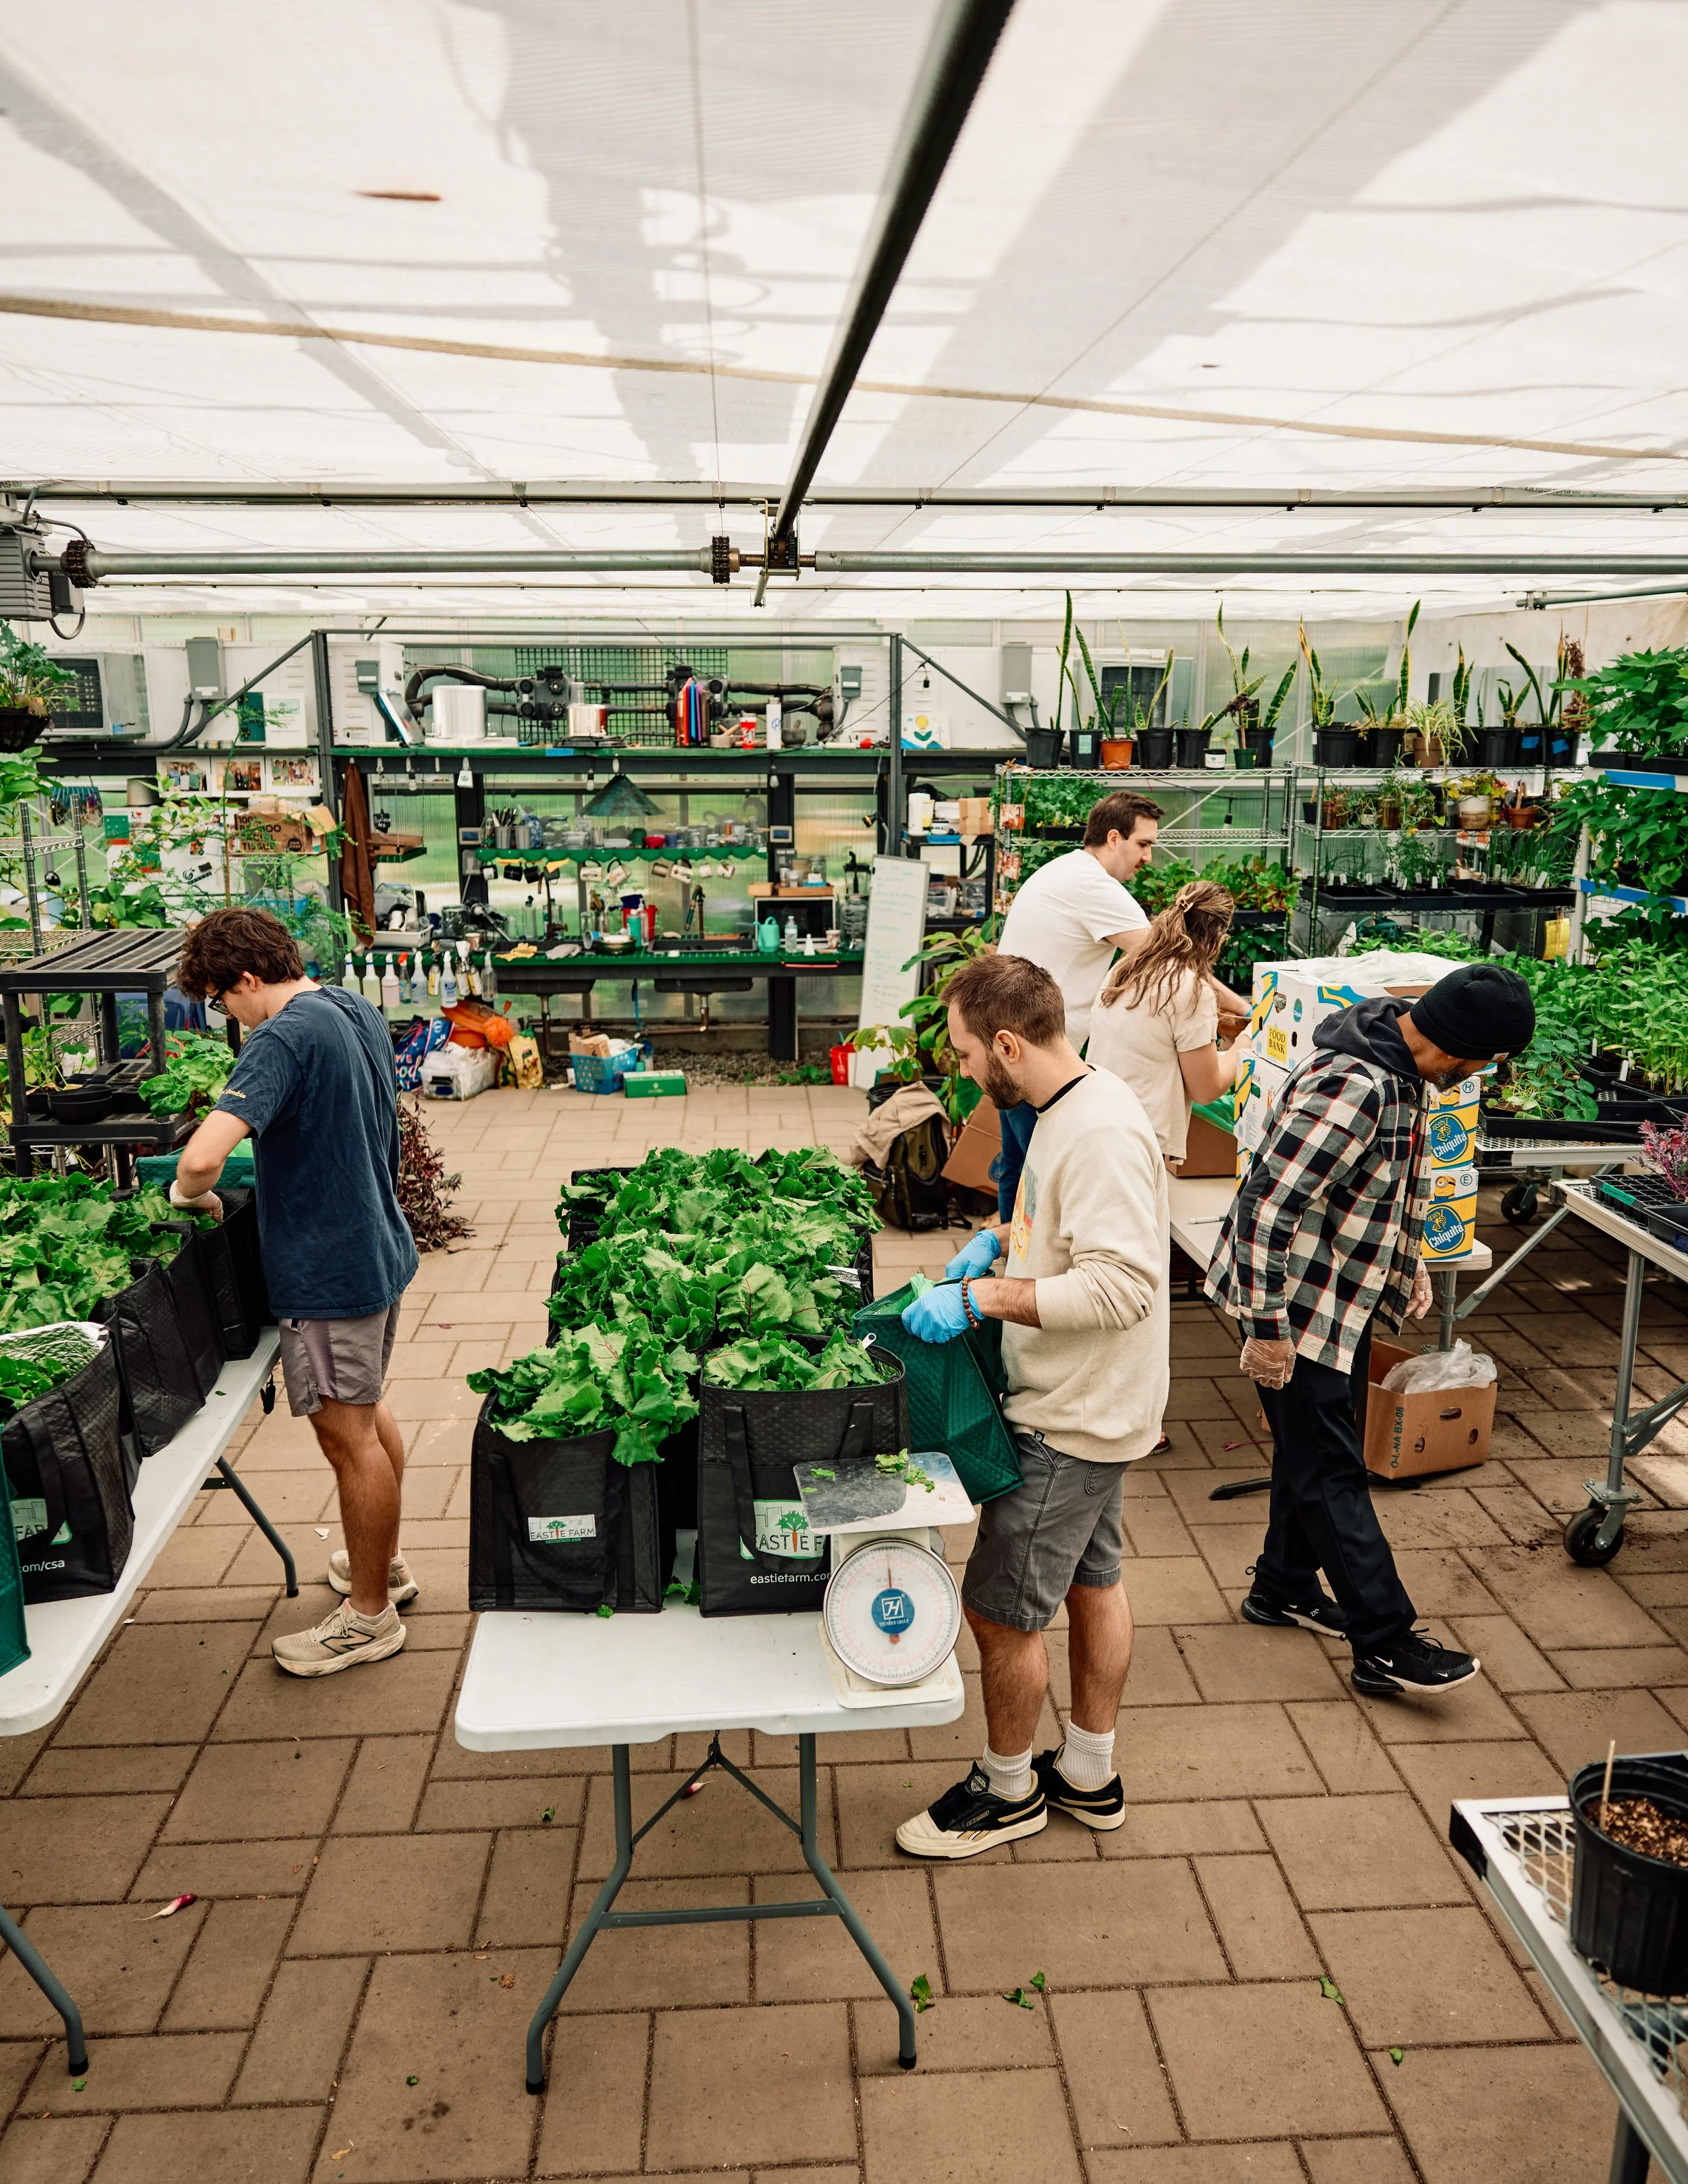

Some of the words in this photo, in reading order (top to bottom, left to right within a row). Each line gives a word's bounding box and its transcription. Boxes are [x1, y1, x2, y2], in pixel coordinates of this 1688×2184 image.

[238, 816, 257, 824] 100
[1269, 1028, 1286, 1043] FOOD
[1269, 1038, 1286, 1054] BANK
[1465, 1084, 1471, 1092] H
[1433, 1133, 1467, 1158] Chiquita
[1463, 1176, 1469, 1184] E
[1428, 1223, 1464, 1248] Chiquita
[1394, 1406, 1404, 1433] BX-08
[569, 1528, 595, 1537] FARM
